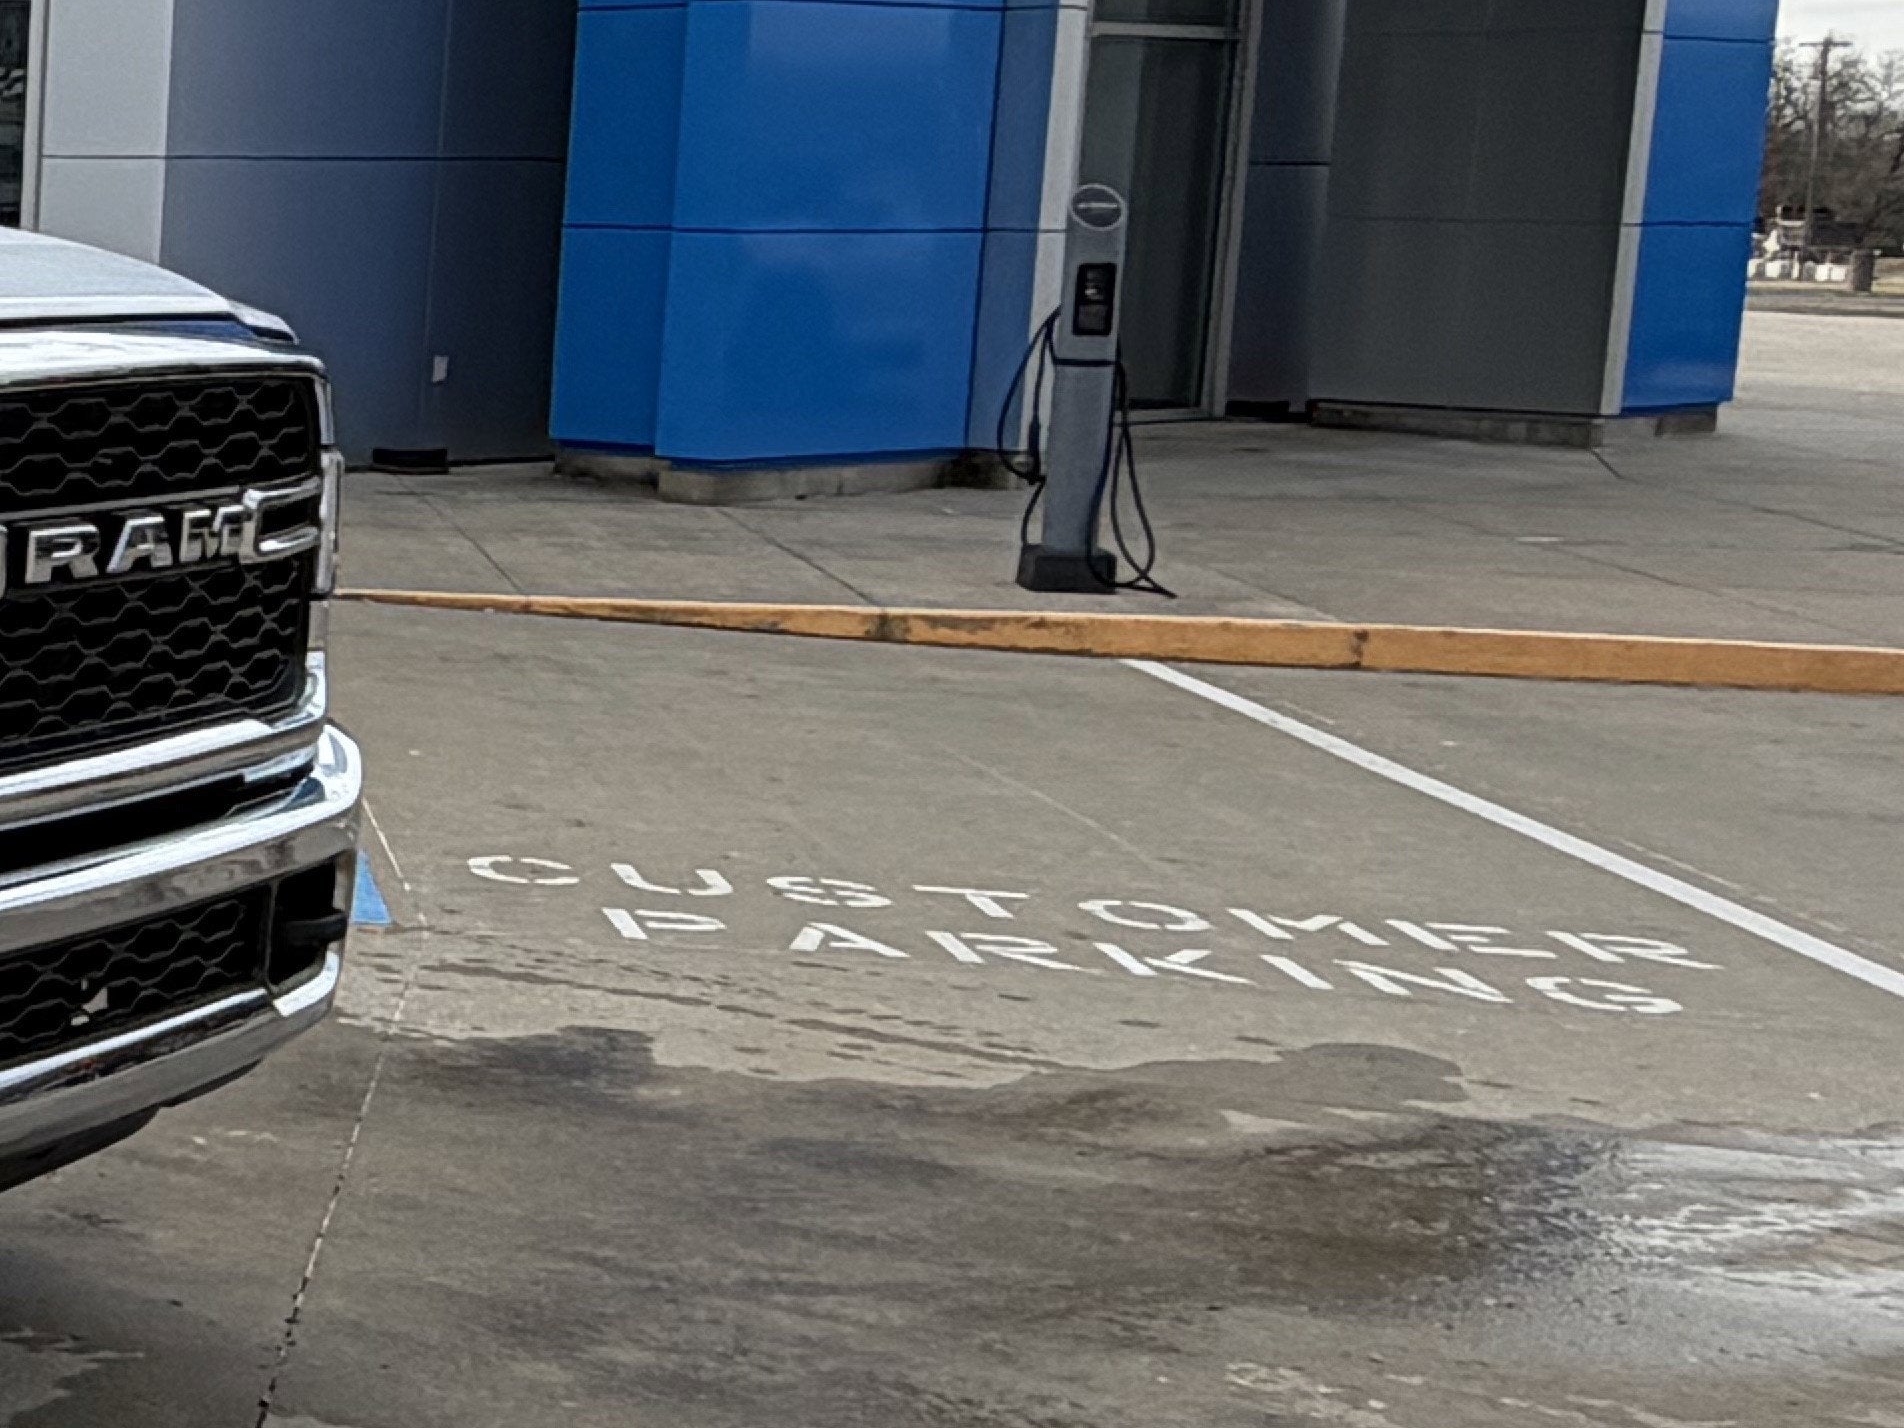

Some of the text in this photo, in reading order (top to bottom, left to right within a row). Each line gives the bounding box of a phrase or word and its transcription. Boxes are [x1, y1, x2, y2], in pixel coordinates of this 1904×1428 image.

[24, 504, 246, 584] RAM
[467, 855, 1725, 970] CUSTOMER
[601, 907, 1684, 1014] PARKING
